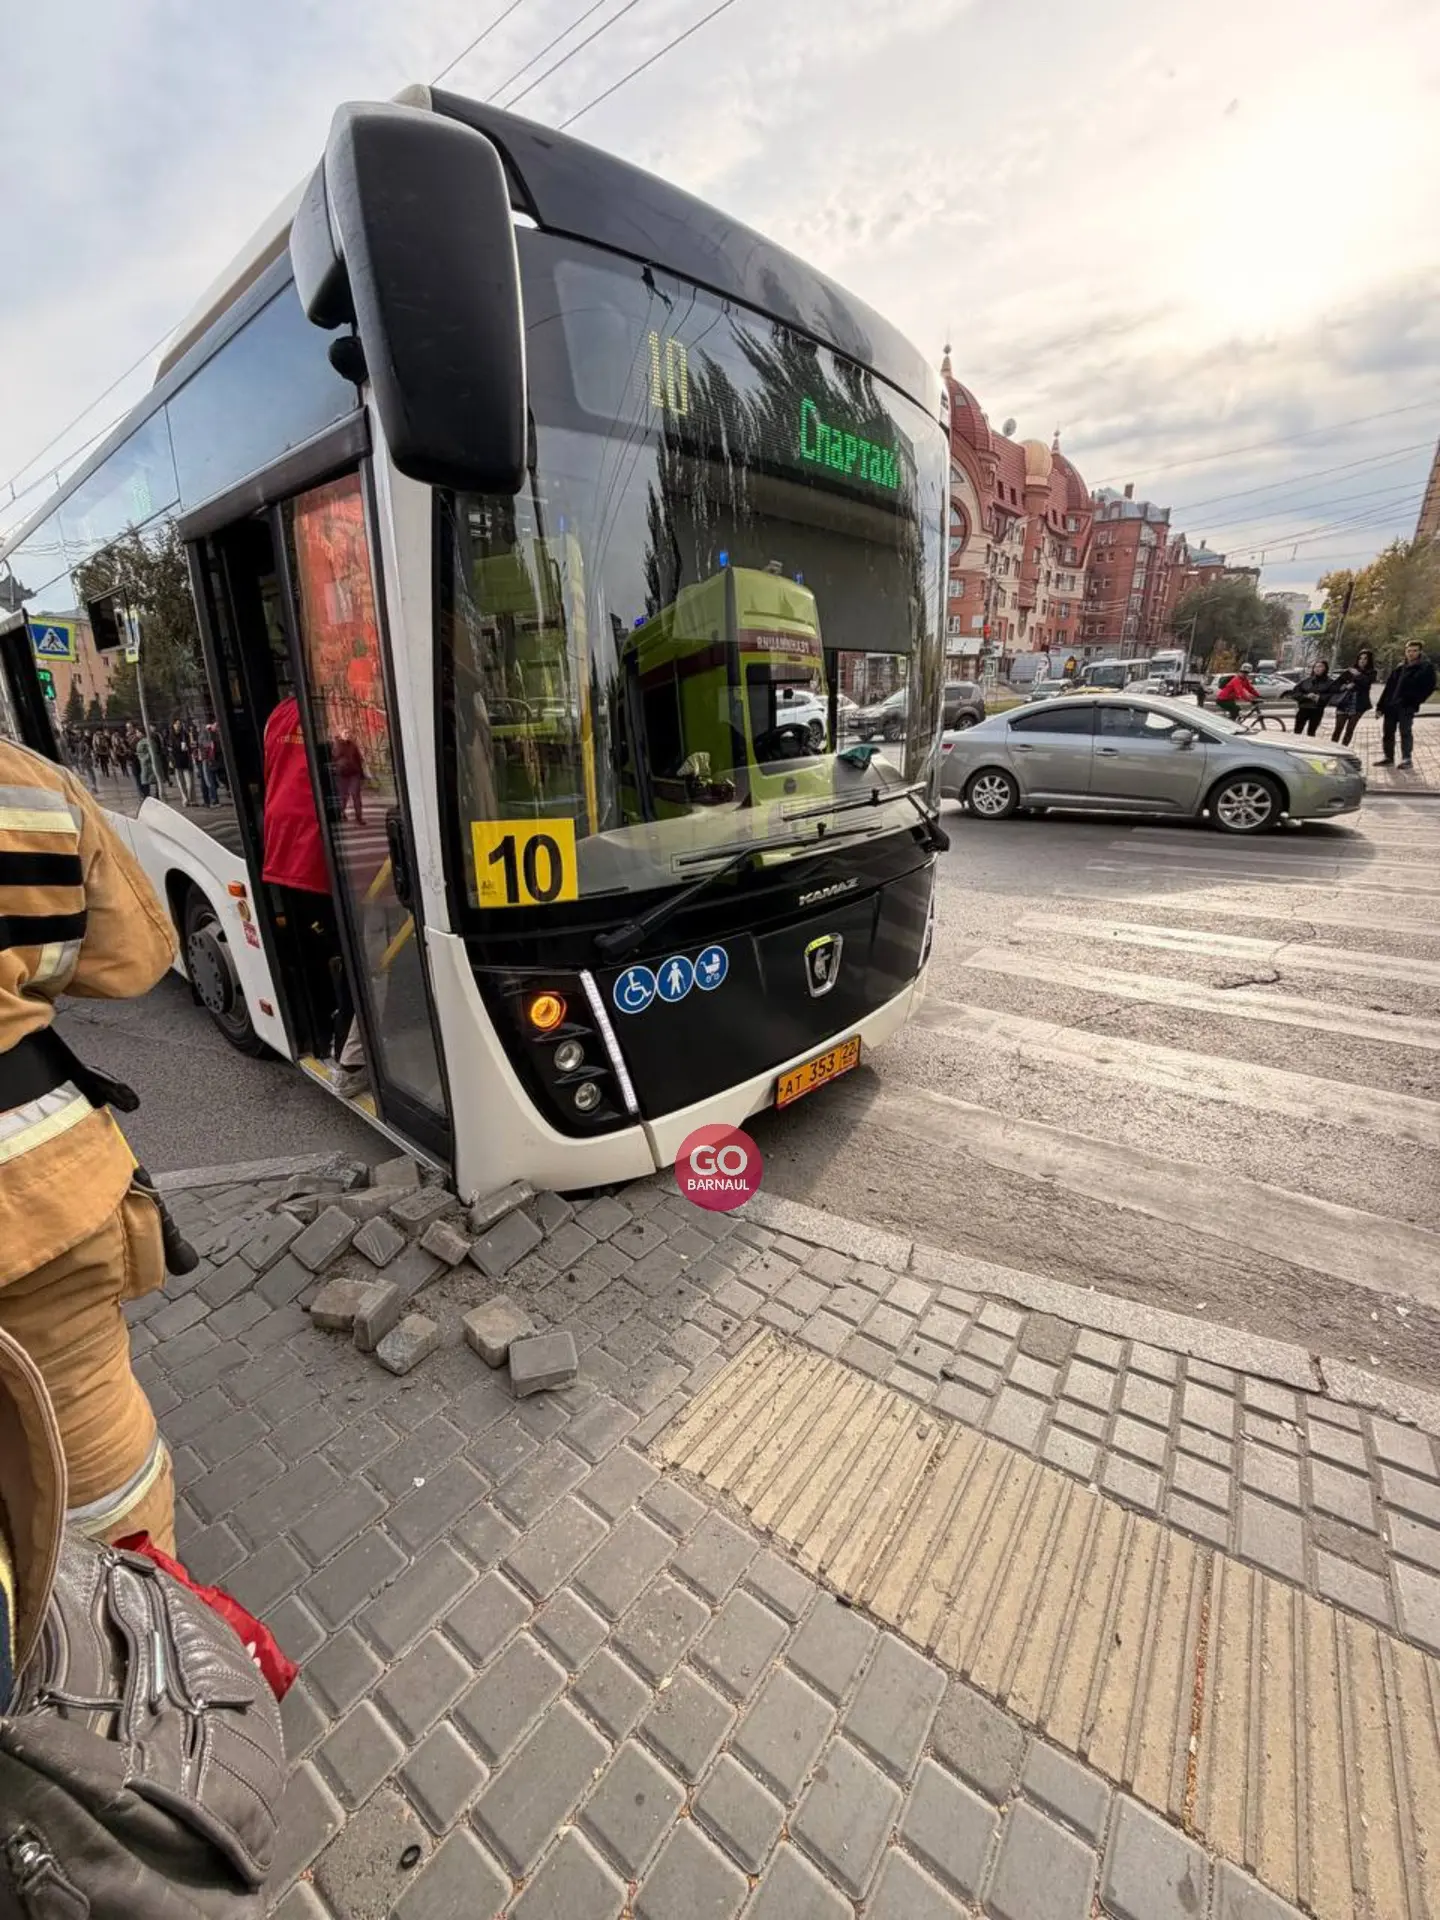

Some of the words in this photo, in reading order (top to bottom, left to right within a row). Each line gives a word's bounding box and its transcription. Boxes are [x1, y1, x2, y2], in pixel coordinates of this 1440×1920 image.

[648, 331, 688, 416] 10
[801, 398, 898, 489] Спартак
[488, 834, 563, 903] 10
[799, 877, 859, 906] KAMAZ
[809, 1052, 836, 1081] 353
[842, 1042, 857, 1059] 22
